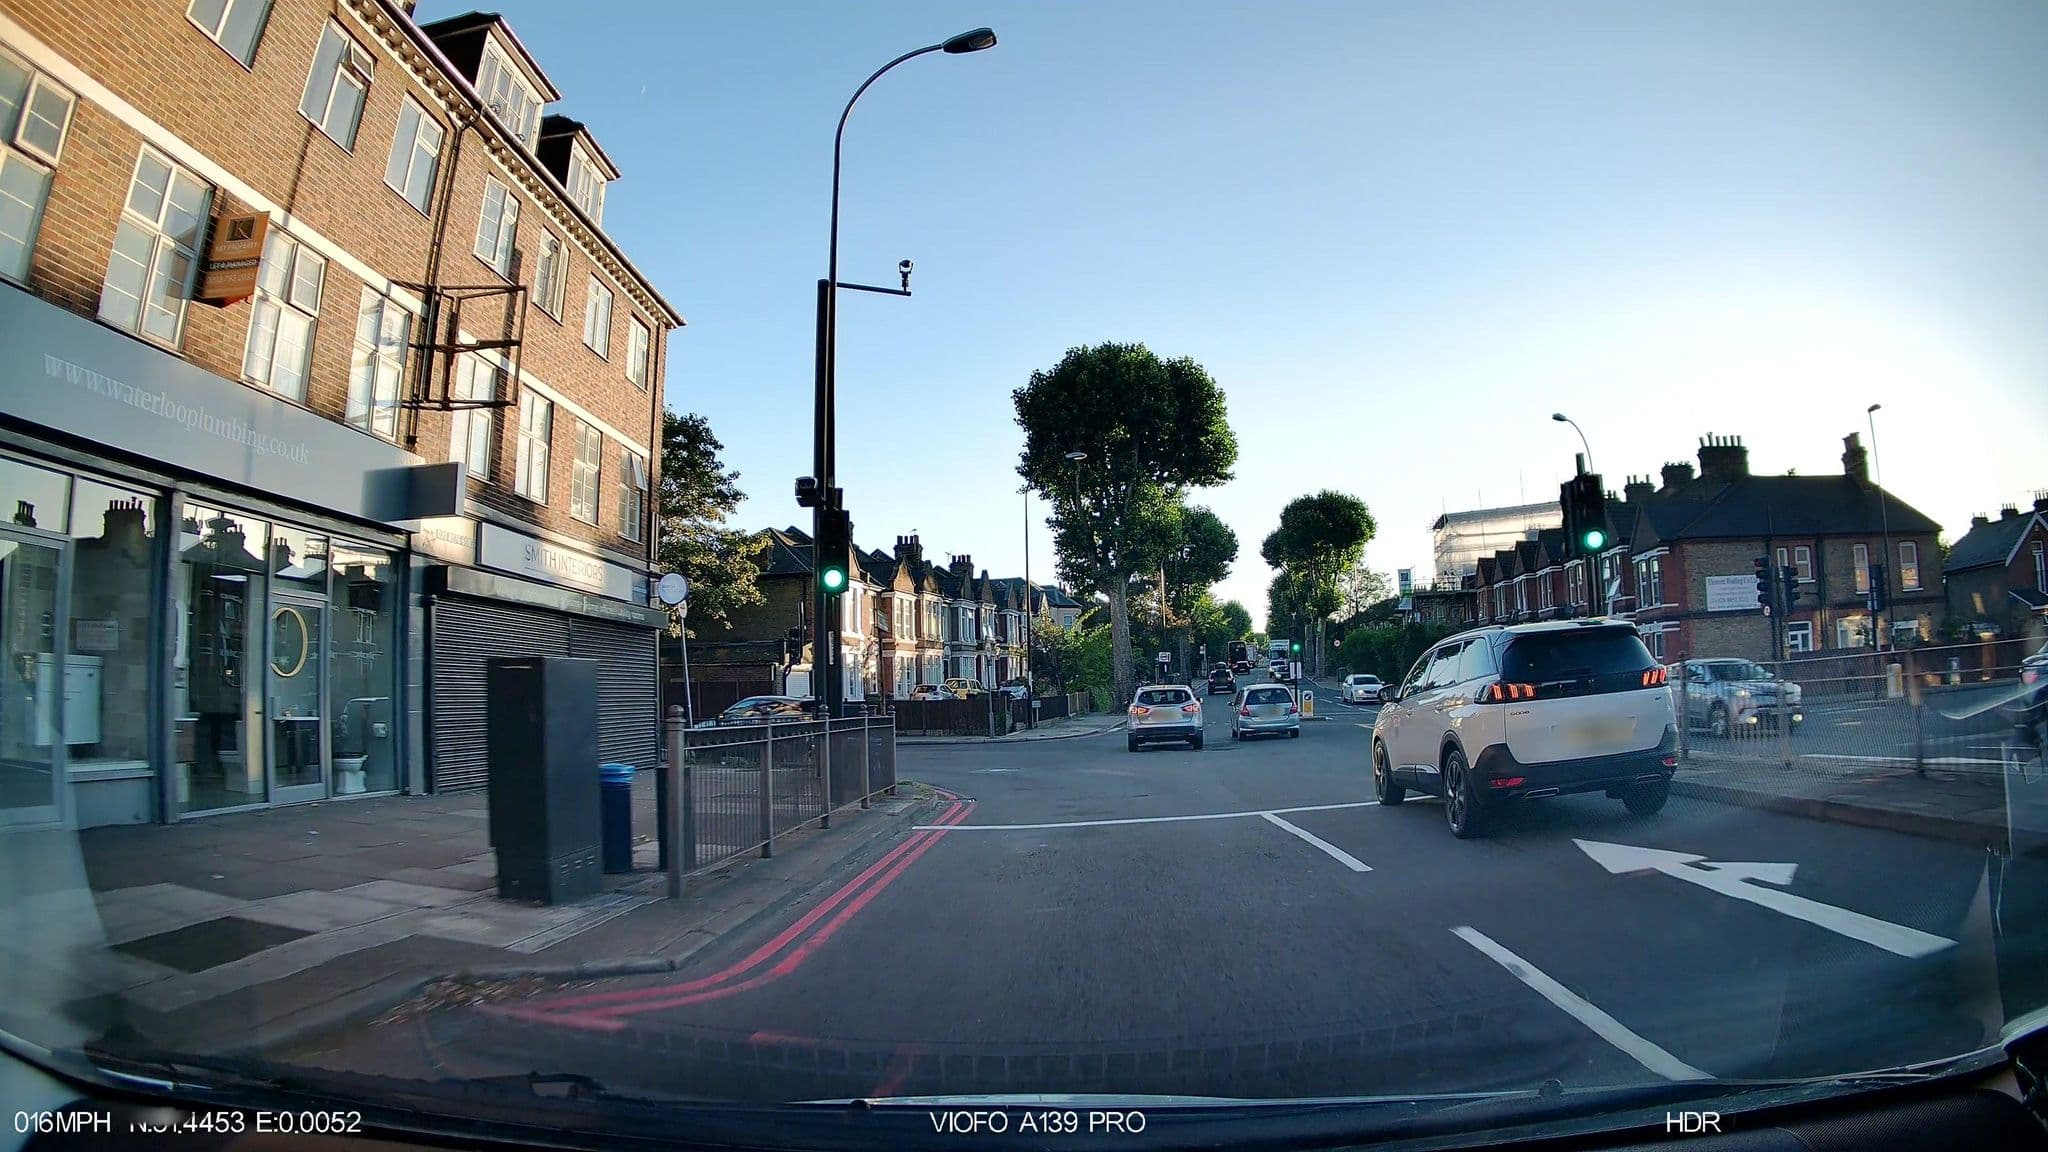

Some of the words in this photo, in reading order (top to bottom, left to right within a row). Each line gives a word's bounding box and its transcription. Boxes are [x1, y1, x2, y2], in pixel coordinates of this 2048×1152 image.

[225, 258, 257, 268] MANAGED
[44, 353, 310, 464] www.waterlooplumbing.co.uk
[524, 543, 557, 569] SMITH
[558, 551, 604, 583] INTERIORS
